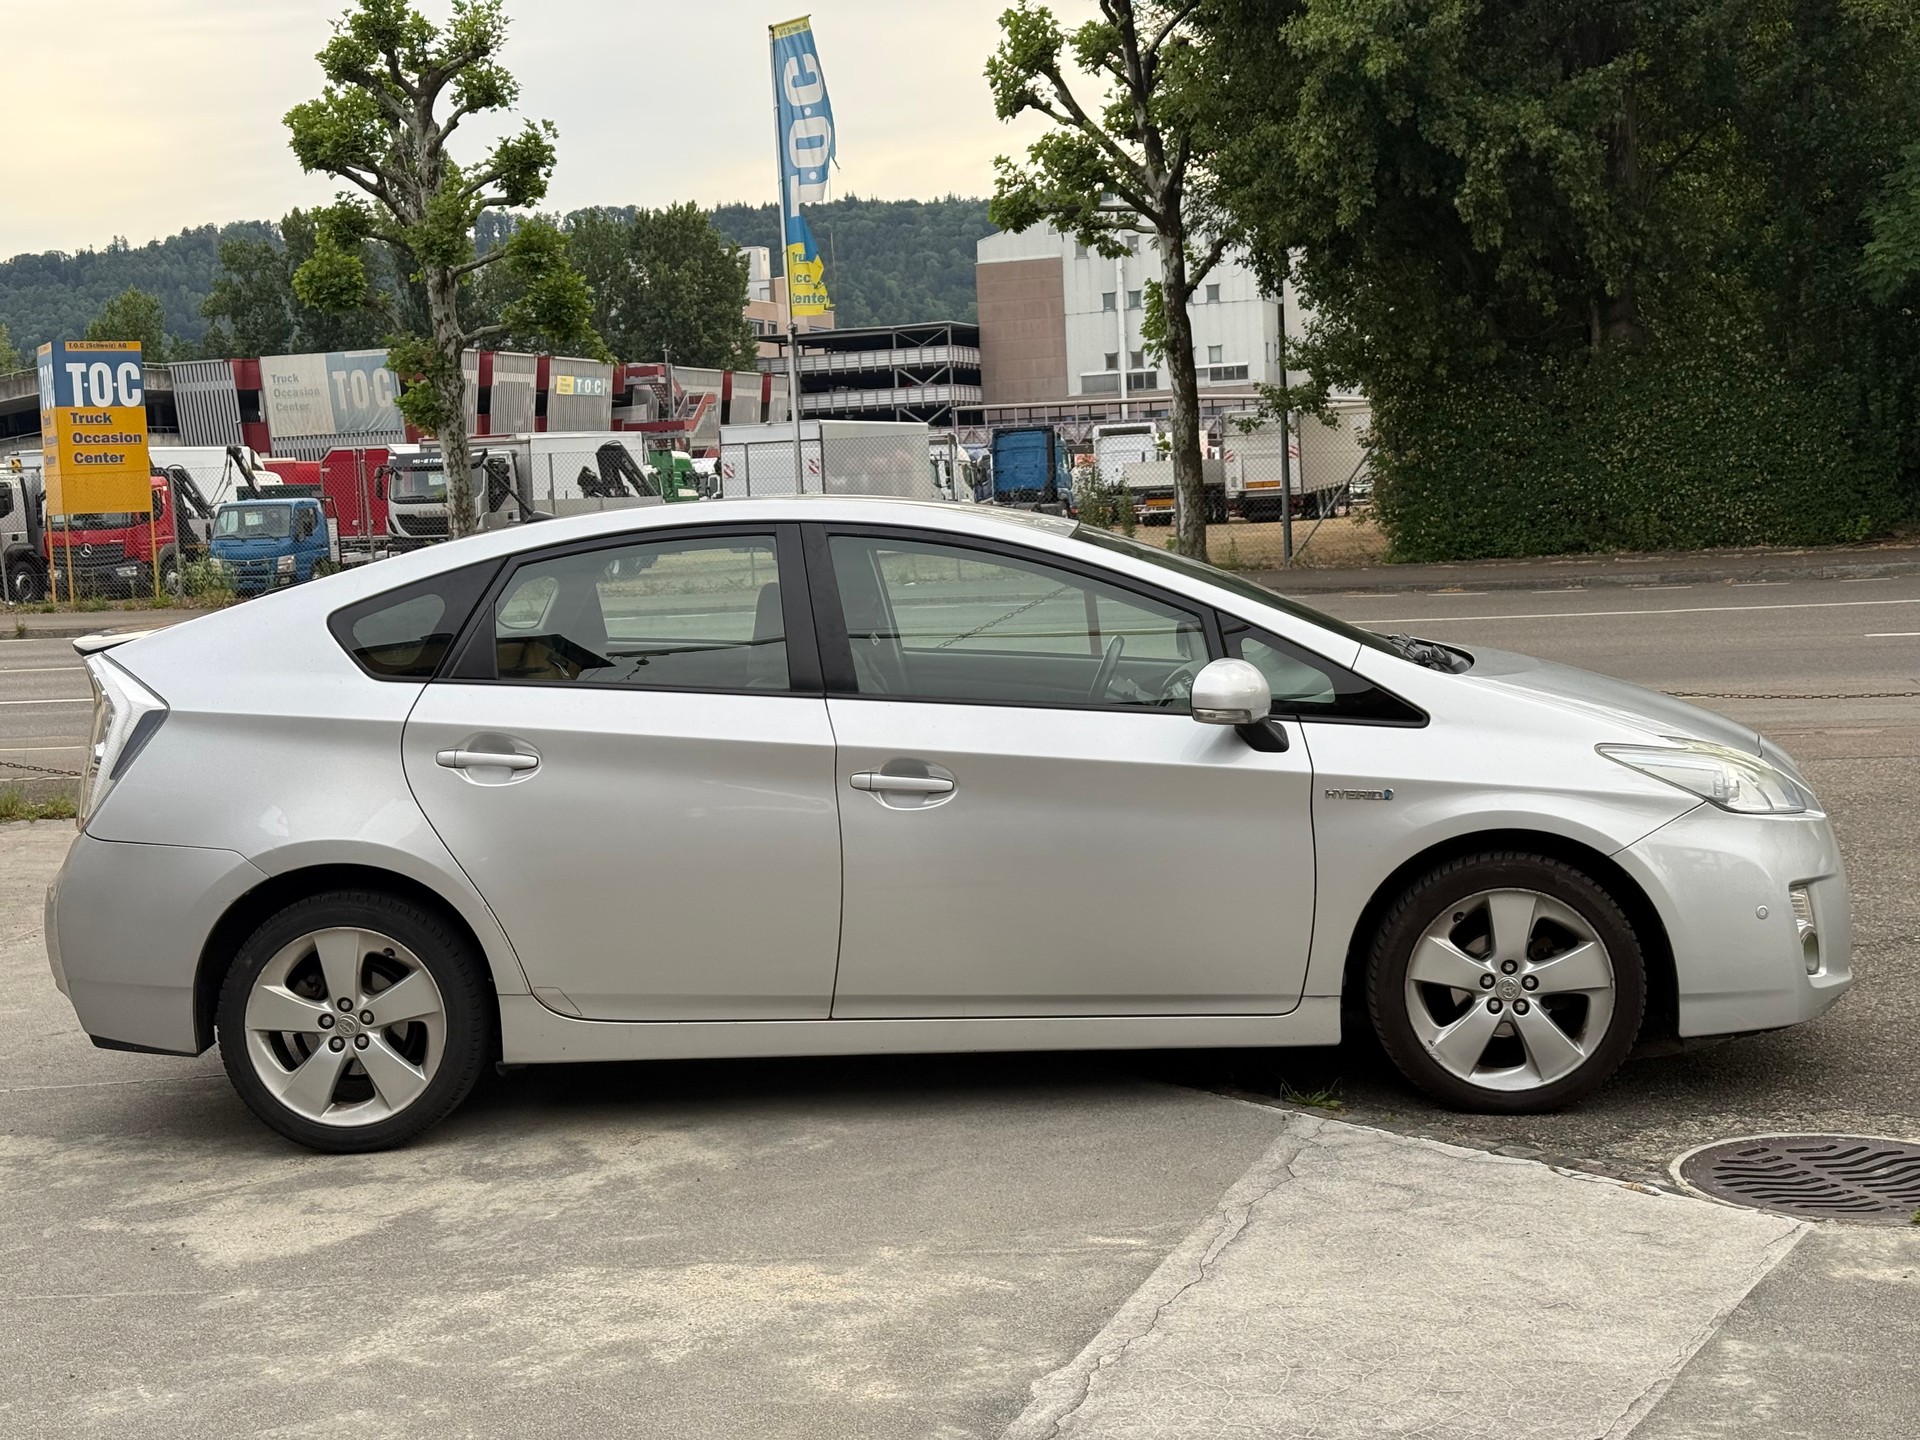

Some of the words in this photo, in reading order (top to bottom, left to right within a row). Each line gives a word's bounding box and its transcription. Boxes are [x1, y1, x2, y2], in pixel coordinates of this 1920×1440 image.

[271, 373, 300, 384] Truck
[273, 387, 321, 398] Occasion
[276, 401, 311, 412] Center
[70, 412, 113, 424] Truck
[72, 432, 142, 444] Occasion
[73, 452, 125, 464] Center
[1324, 788, 1384, 801] HYBRID
